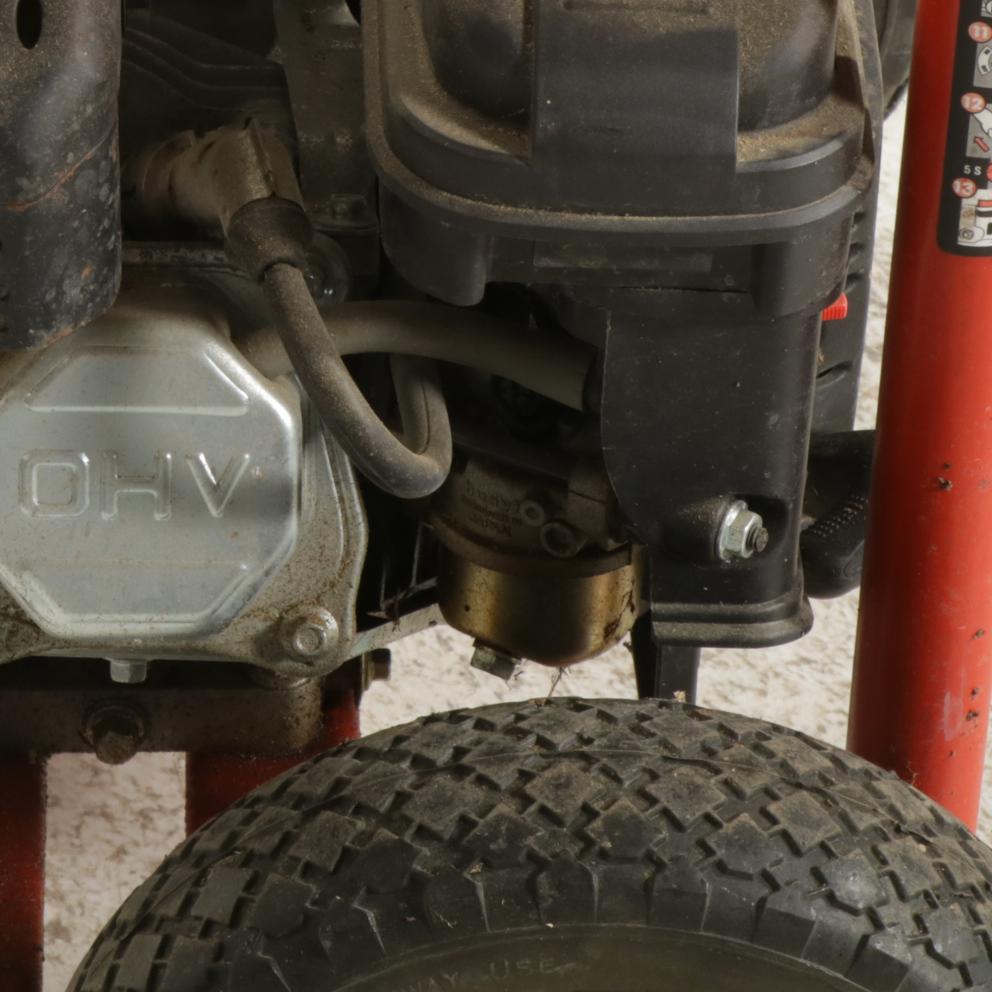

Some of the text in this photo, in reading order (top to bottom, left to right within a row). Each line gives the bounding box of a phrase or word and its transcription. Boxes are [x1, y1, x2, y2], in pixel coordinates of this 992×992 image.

[963, 165, 982, 176] 5 S
[18, 448, 251, 521] OHV
